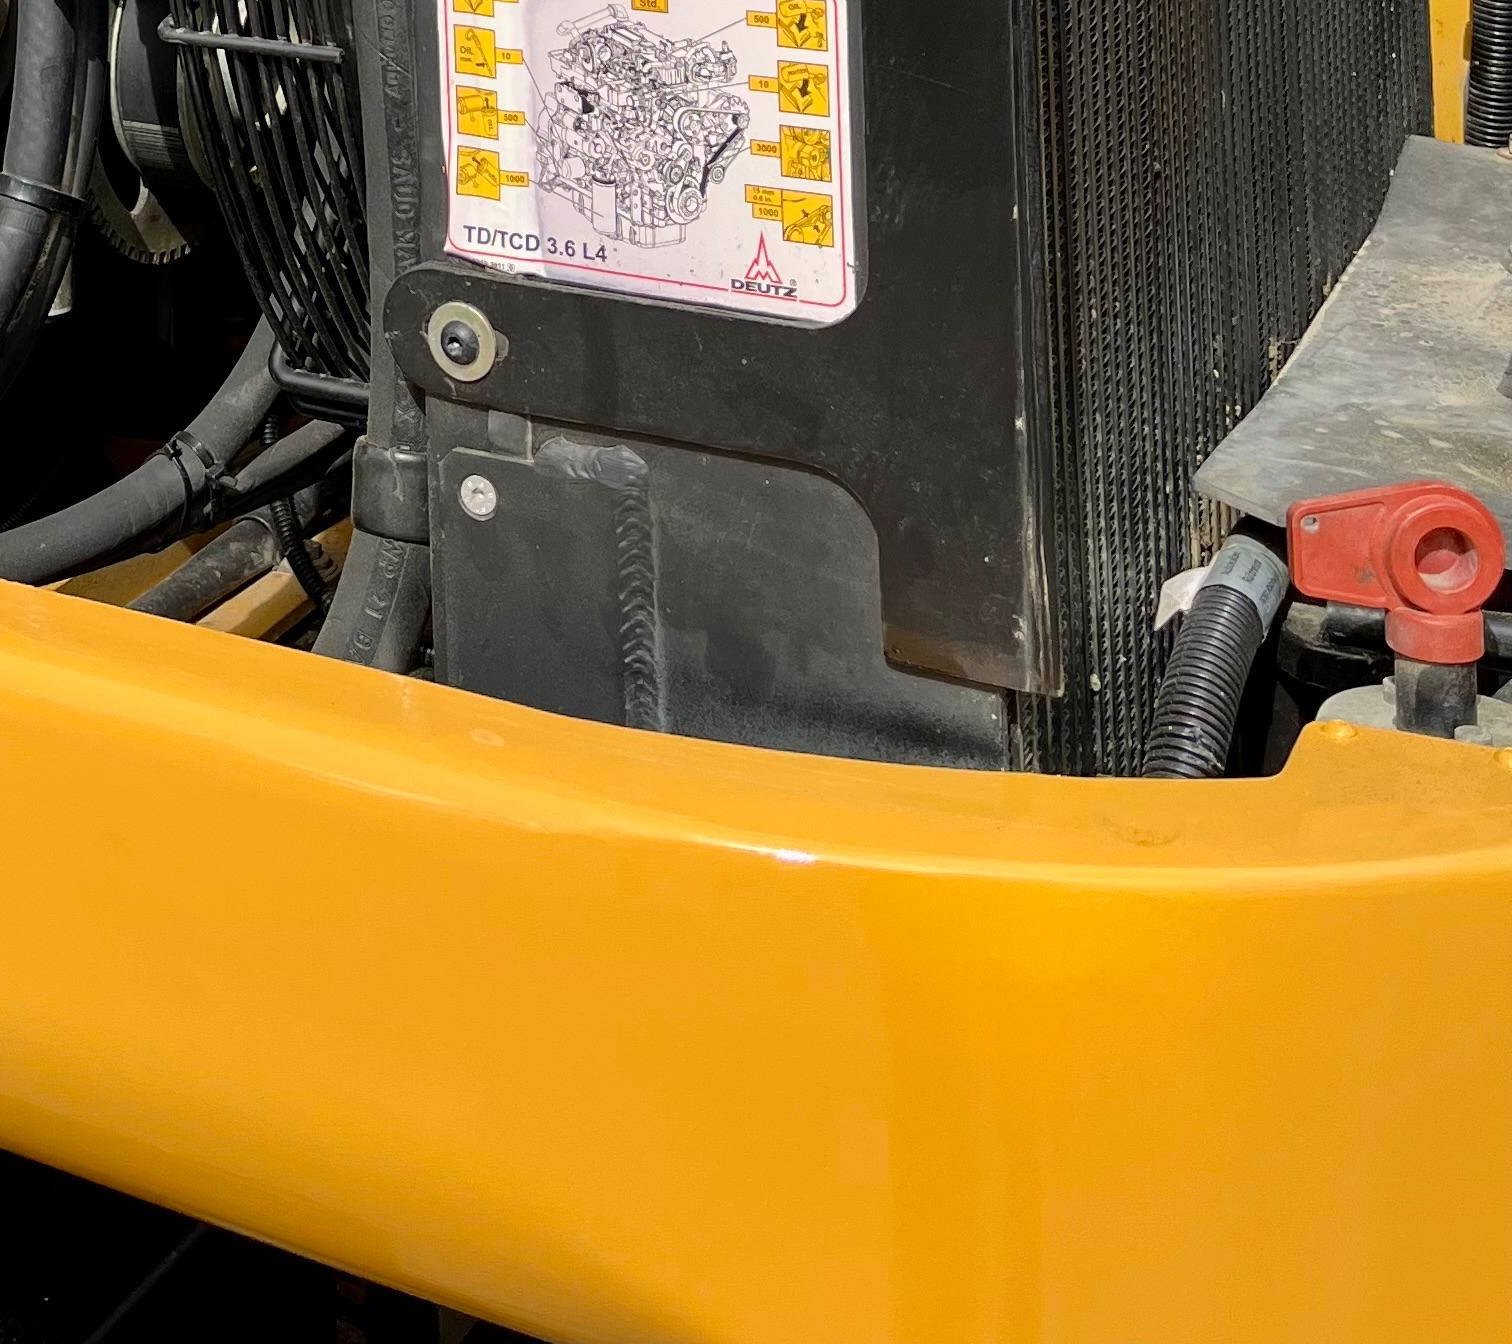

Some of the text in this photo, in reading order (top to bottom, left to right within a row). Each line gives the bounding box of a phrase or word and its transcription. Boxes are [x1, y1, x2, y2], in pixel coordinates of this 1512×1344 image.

[753, 14, 770, 24] 500
[501, 52, 511, 60] 10
[758, 79, 769, 89] 10
[503, 113, 519, 122] 500
[756, 142, 777, 154] 3000
[505, 173, 525, 184] 1000
[758, 207, 779, 218] 1000
[463, 225, 608, 262] TD/TCD 3.6 L4
[731, 278, 798, 298] DEUTZ
